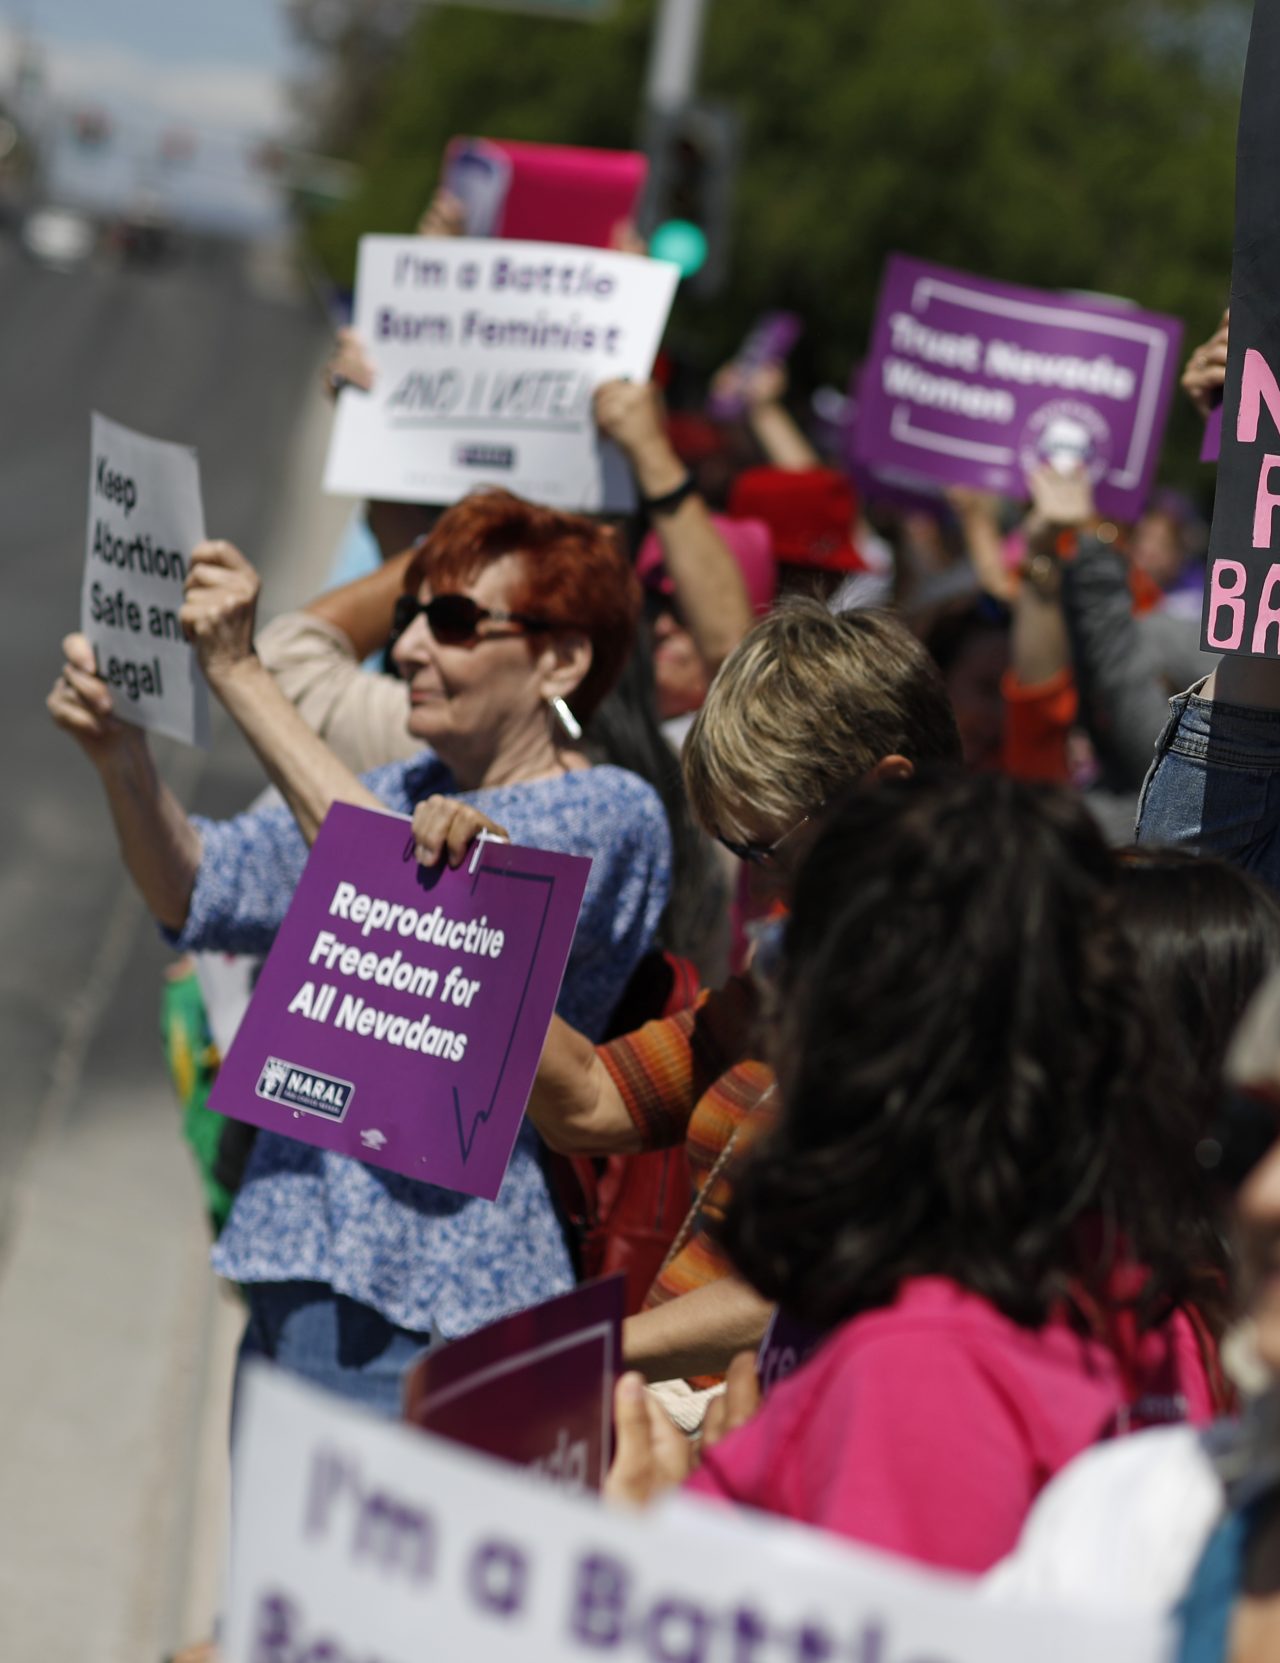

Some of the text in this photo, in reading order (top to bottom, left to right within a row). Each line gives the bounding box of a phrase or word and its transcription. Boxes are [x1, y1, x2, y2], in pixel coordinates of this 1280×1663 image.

[394, 254, 445, 288] I'm
[377, 307, 621, 352] Born Feminist
[985, 339, 1134, 399] Nevada
[96, 455, 136, 516] Keep
[93, 518, 187, 581] Abortion
[90, 580, 142, 634] Safe
[329, 880, 505, 958] Reproductive
[309, 930, 481, 1008] Freedom for
[287, 981, 468, 1062] All Nevadans
[287, 1071, 344, 1107] NARAL
[306, 1441, 438, 1589] I'm
[468, 1539, 530, 1619] a
[570, 1551, 956, 1663] Bat
